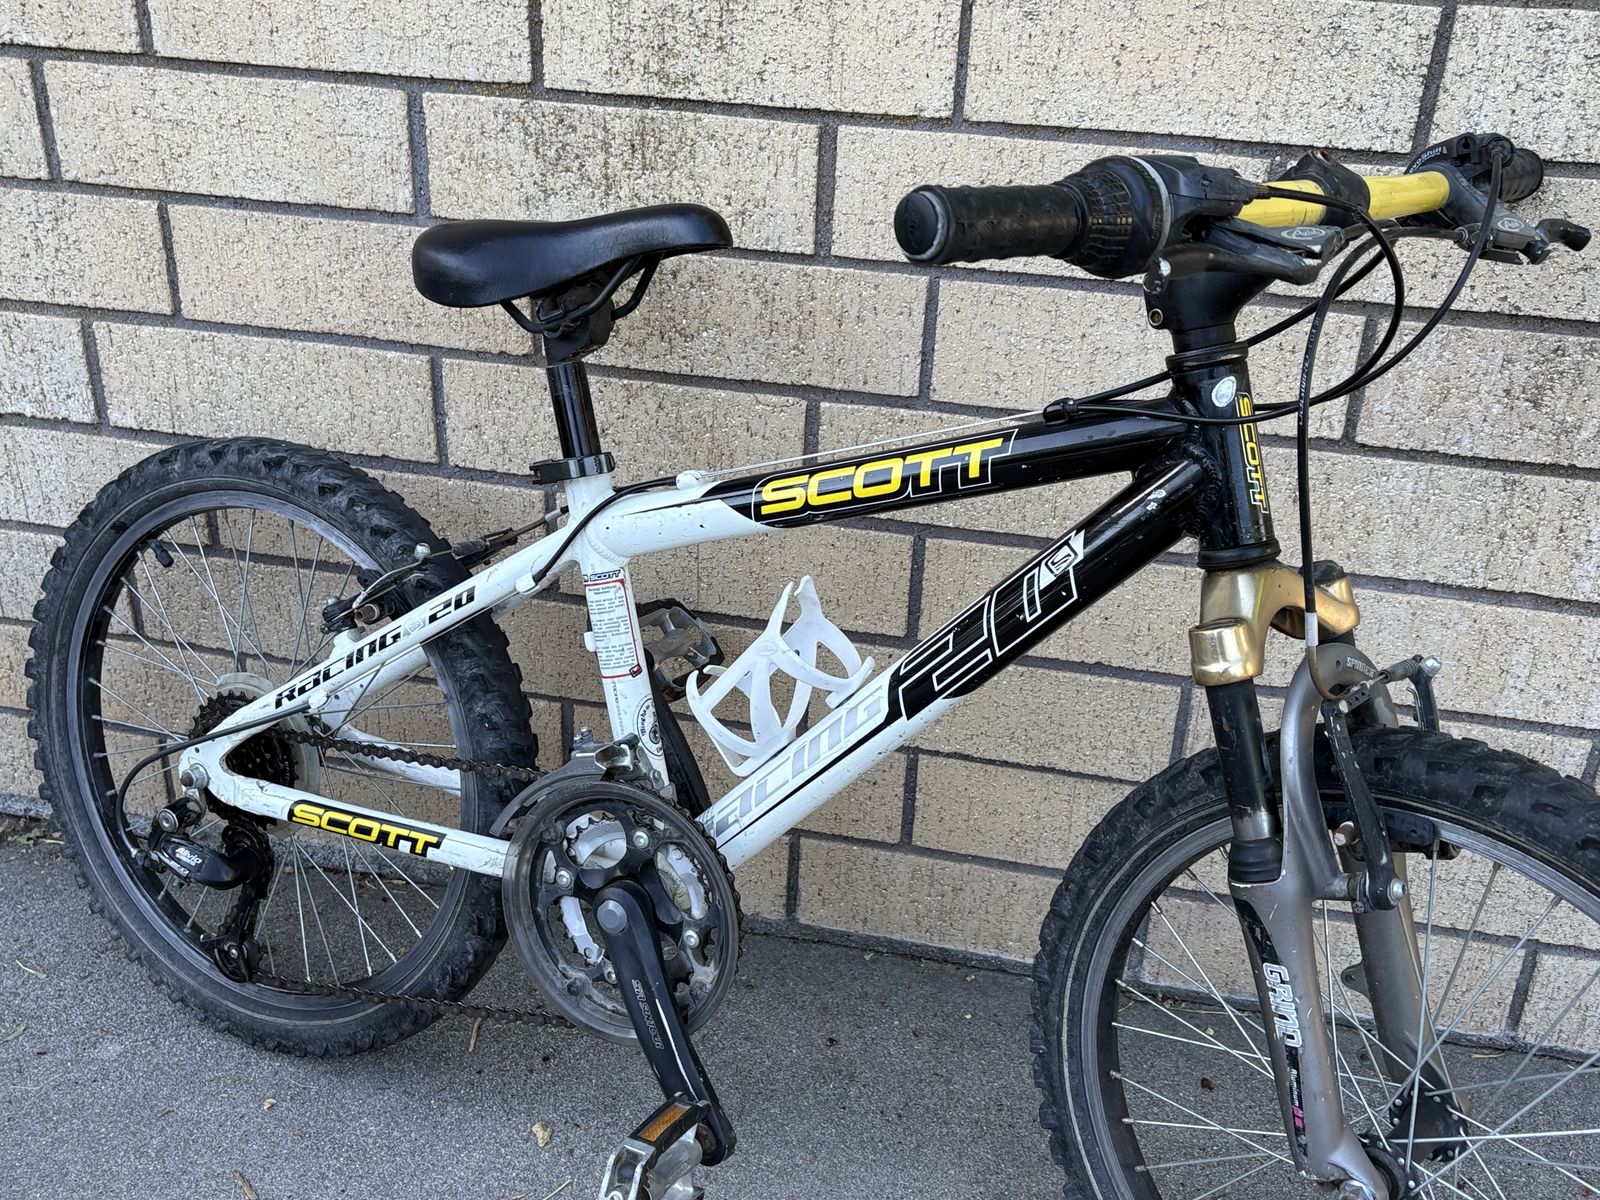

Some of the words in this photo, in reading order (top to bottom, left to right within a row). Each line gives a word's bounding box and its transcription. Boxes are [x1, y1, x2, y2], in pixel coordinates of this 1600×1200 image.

[761, 437, 1004, 515] SCOTT
[1238, 395, 1267, 509] SCOTT
[428, 585, 476, 625] 20
[590, 570, 621, 582] SCOTT
[291, 803, 439, 855] SCOTT
[1262, 962, 1302, 1048] GRIND
